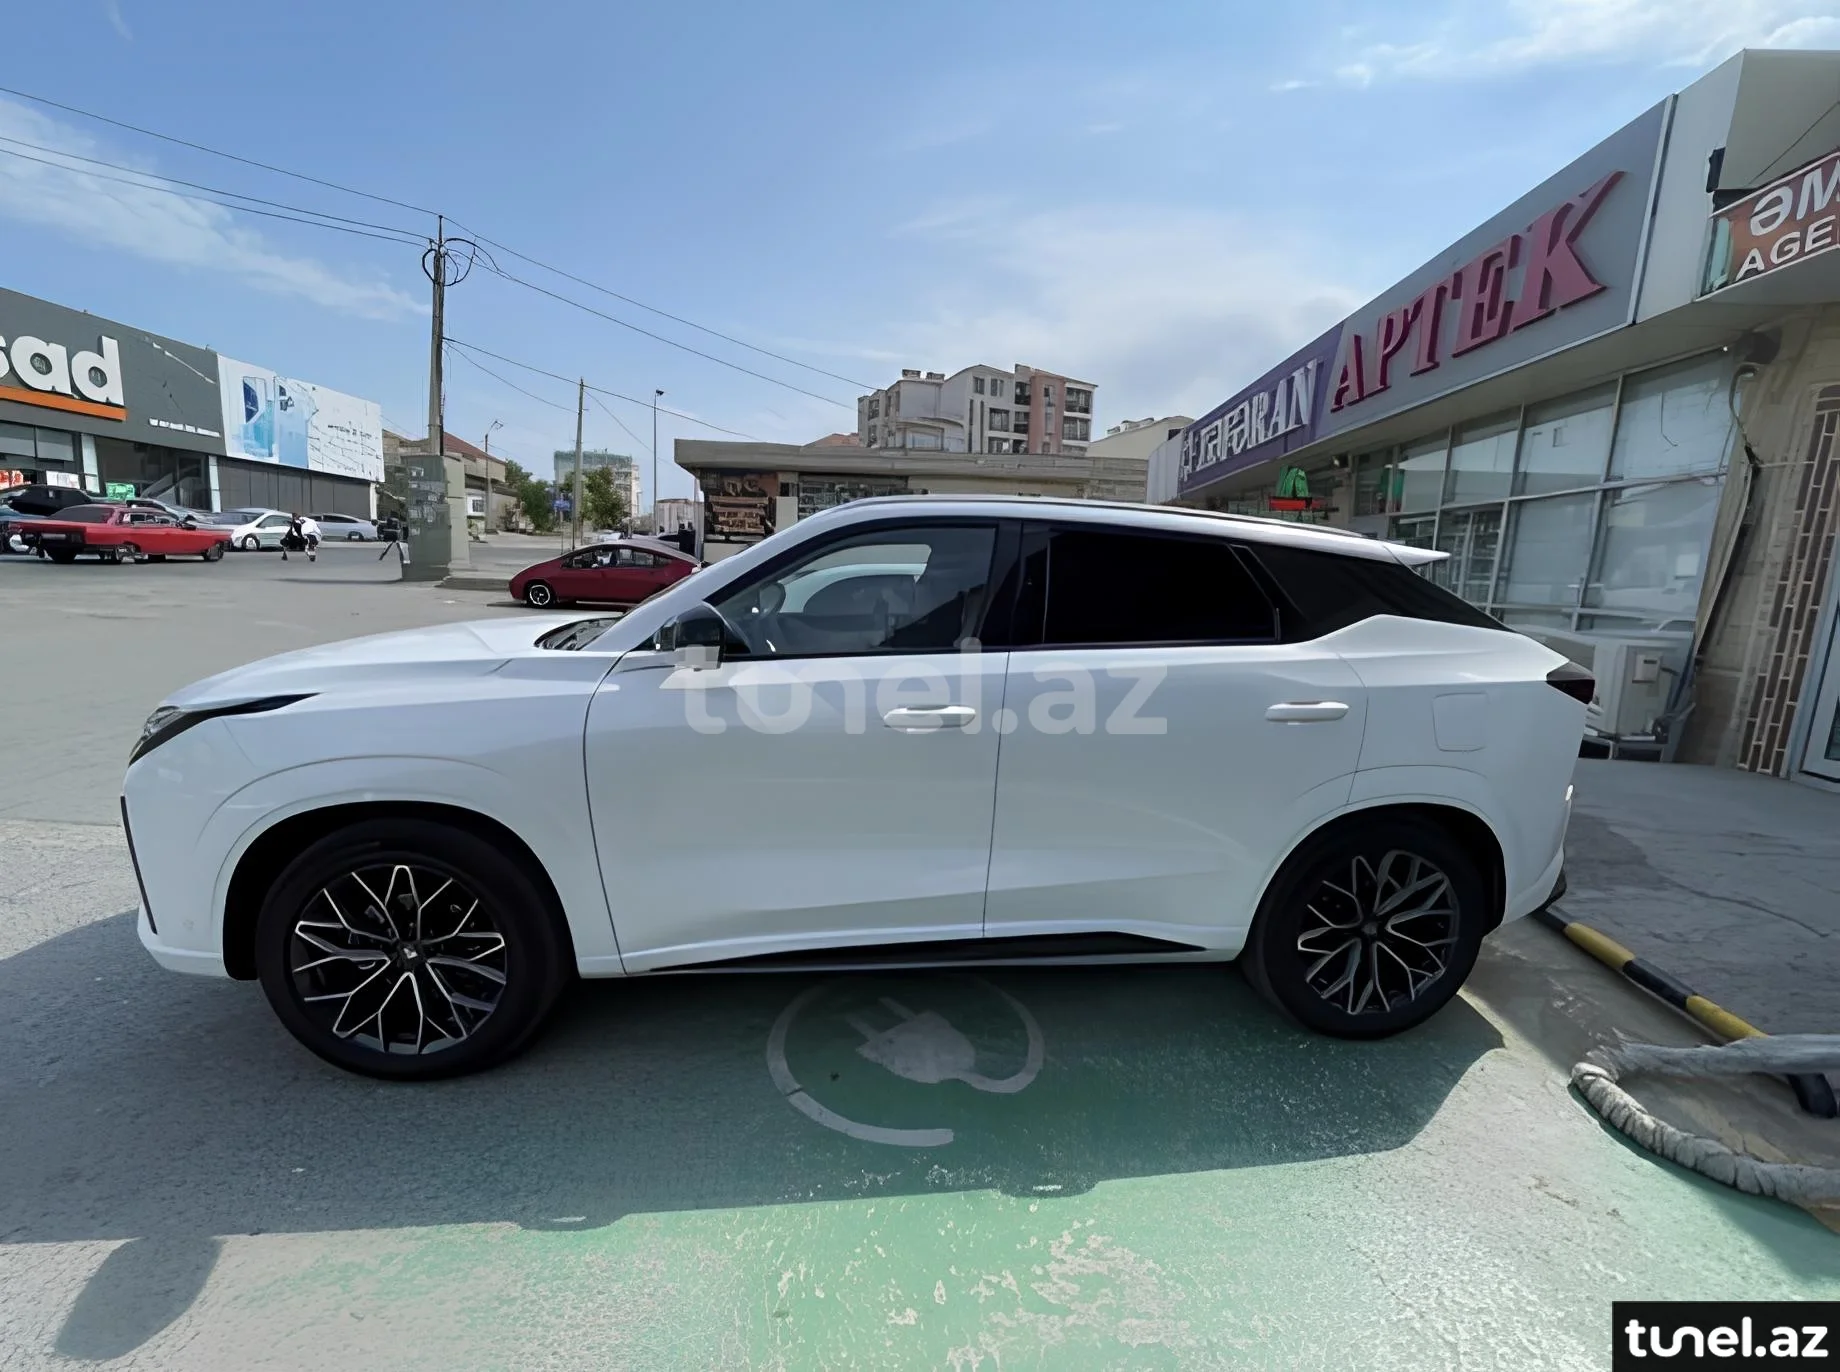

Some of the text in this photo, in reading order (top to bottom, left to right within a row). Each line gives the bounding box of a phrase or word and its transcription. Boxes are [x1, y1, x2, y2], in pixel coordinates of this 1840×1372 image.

[1736, 215, 1840, 281] AGE
[1330, 171, 1627, 413] APTEK
[0, 335, 125, 406] ad
